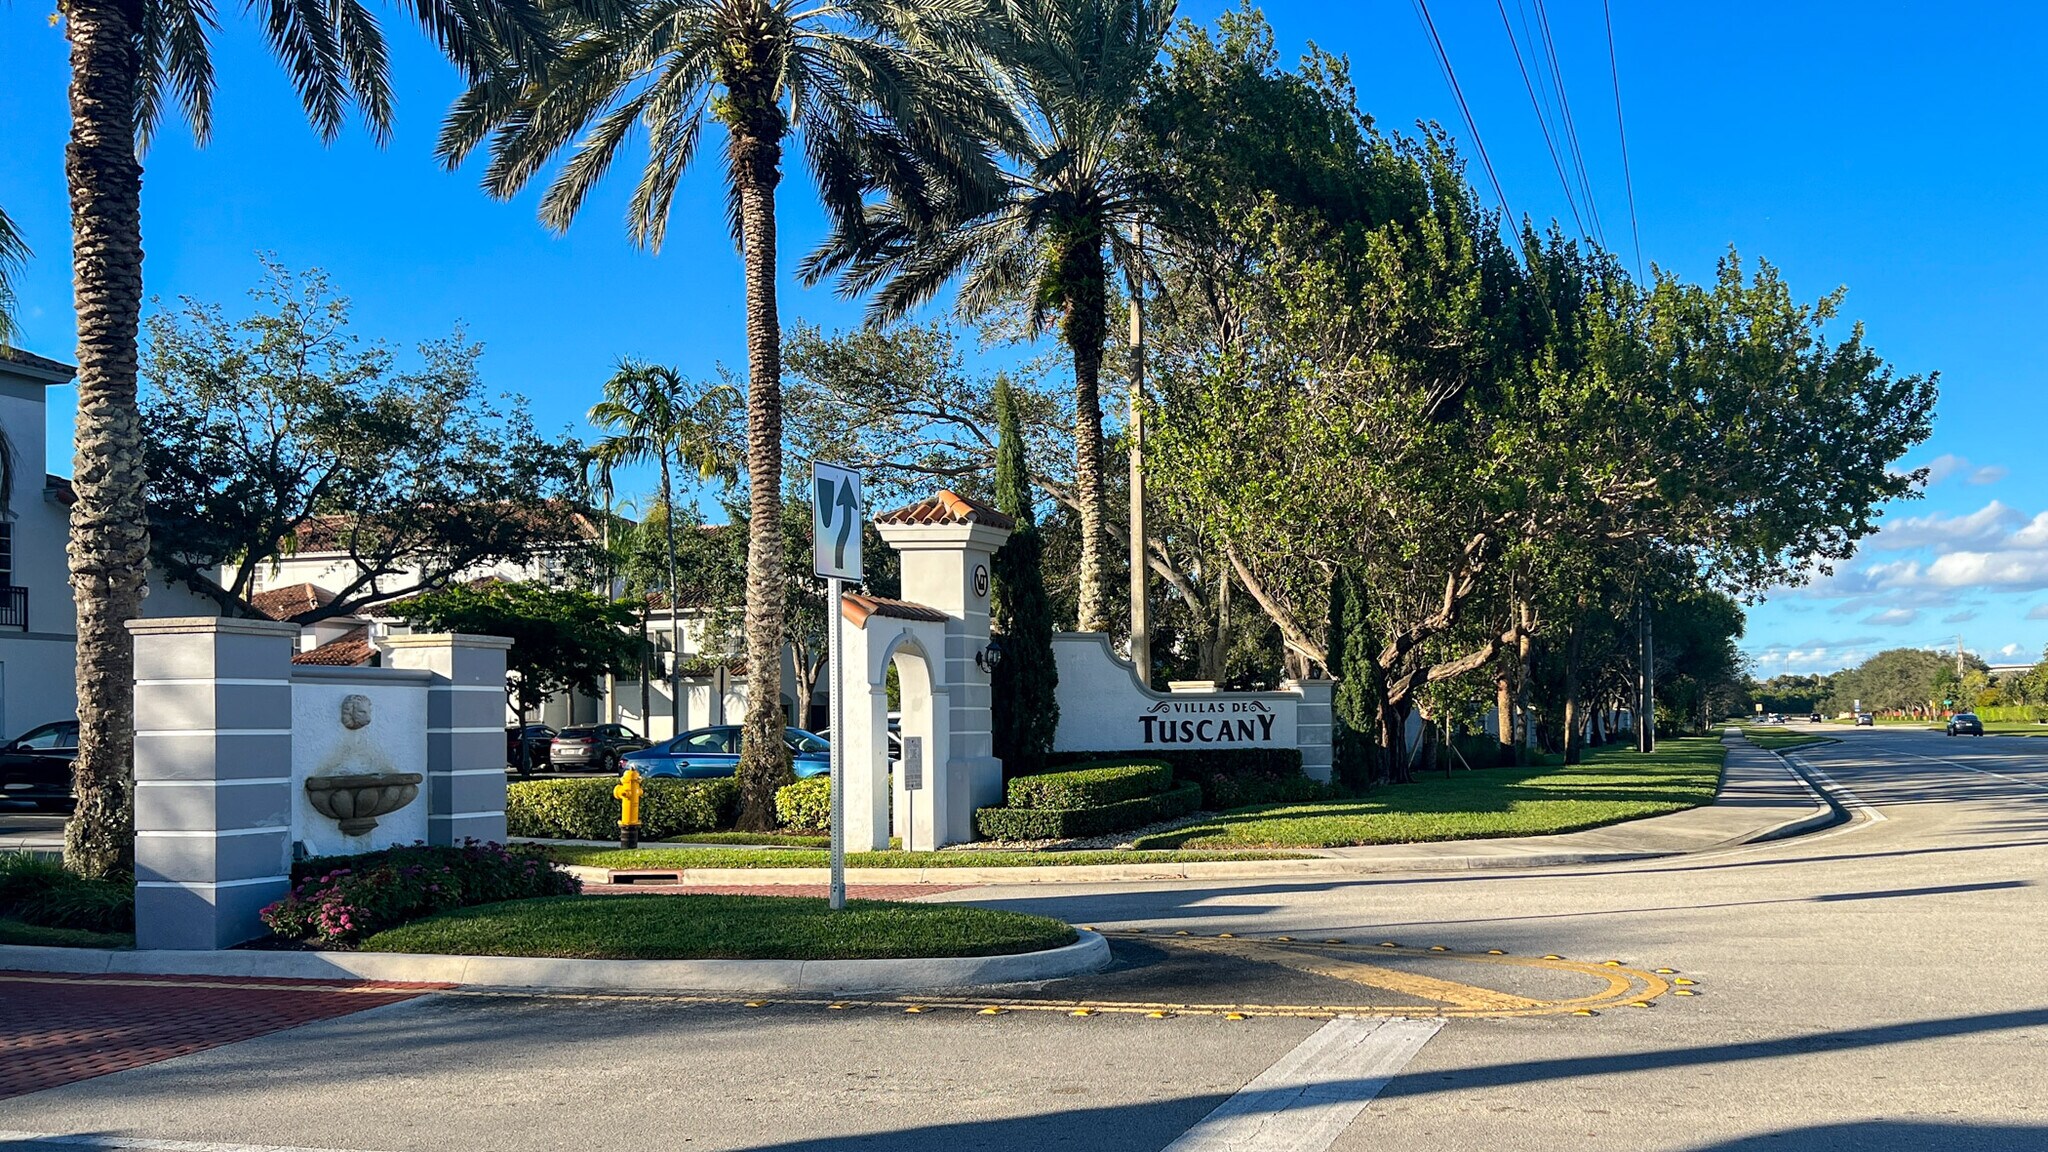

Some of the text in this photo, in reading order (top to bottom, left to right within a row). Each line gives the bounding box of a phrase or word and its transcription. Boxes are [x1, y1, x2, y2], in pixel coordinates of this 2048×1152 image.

[1174, 702, 1248, 713] VILLAS DE
[1138, 714, 1276, 743] TUSCANY
